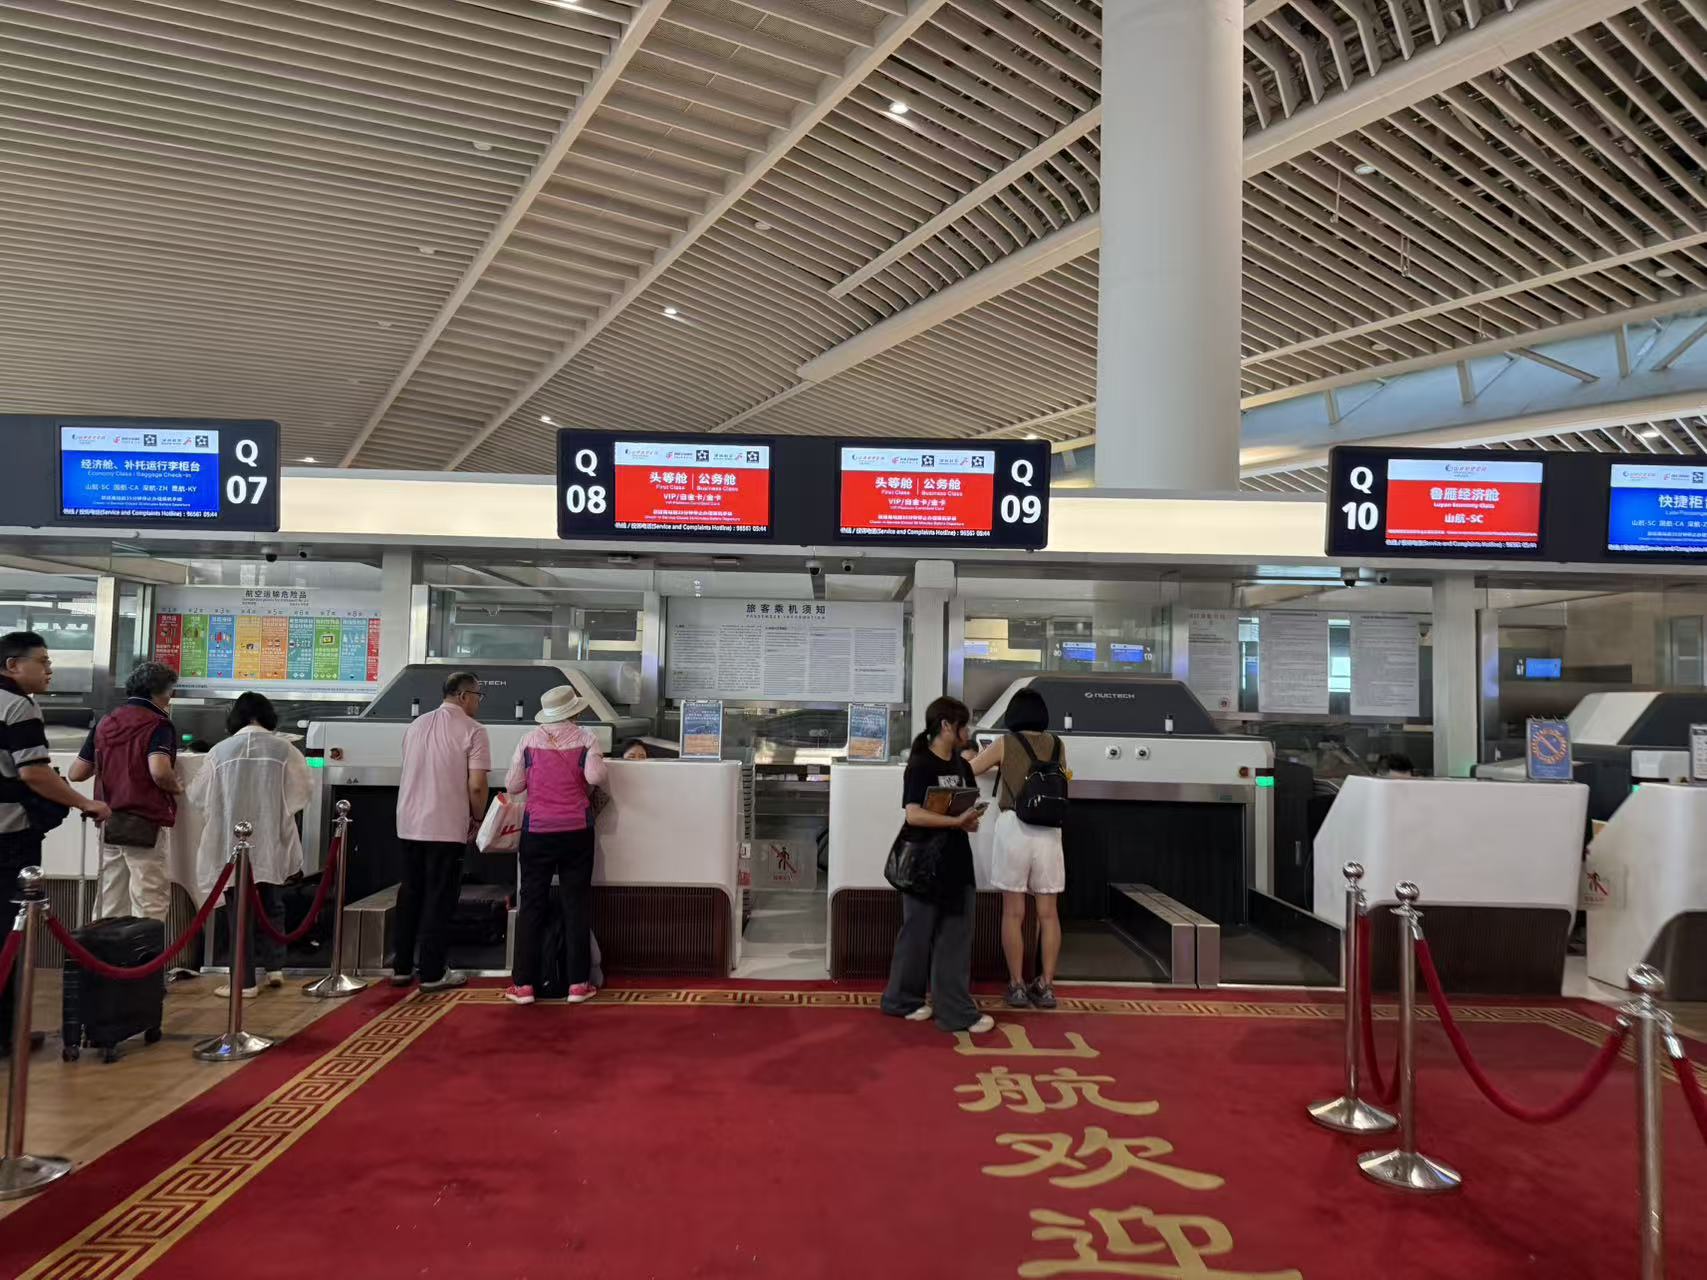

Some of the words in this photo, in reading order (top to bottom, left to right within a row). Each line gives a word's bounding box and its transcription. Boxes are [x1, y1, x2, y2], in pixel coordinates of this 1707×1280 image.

[235, 439, 259, 467] Q
[575, 449, 598, 477] Q
[649, 472, 688, 485] 头等舱
[698, 473, 737, 486] 公务舱
[875, 477, 913, 489] 头等舱
[924, 478, 961, 490] 公务舱
[1011, 459, 1034, 487] Q
[1350, 466, 1374, 494] Q
[226, 475, 268, 505] 07
[566, 484, 607, 514] 08
[1658, 494, 1707, 509] 快捷柜
[1000, 494, 1042, 524] 09
[1341, 501, 1379, 531] 10
[1444, 513, 1484, 524] 山航-SC
[746, 603, 826, 614] 旅客乘机须知
[953, 1020, 1303, 1280] 山航欢迎
